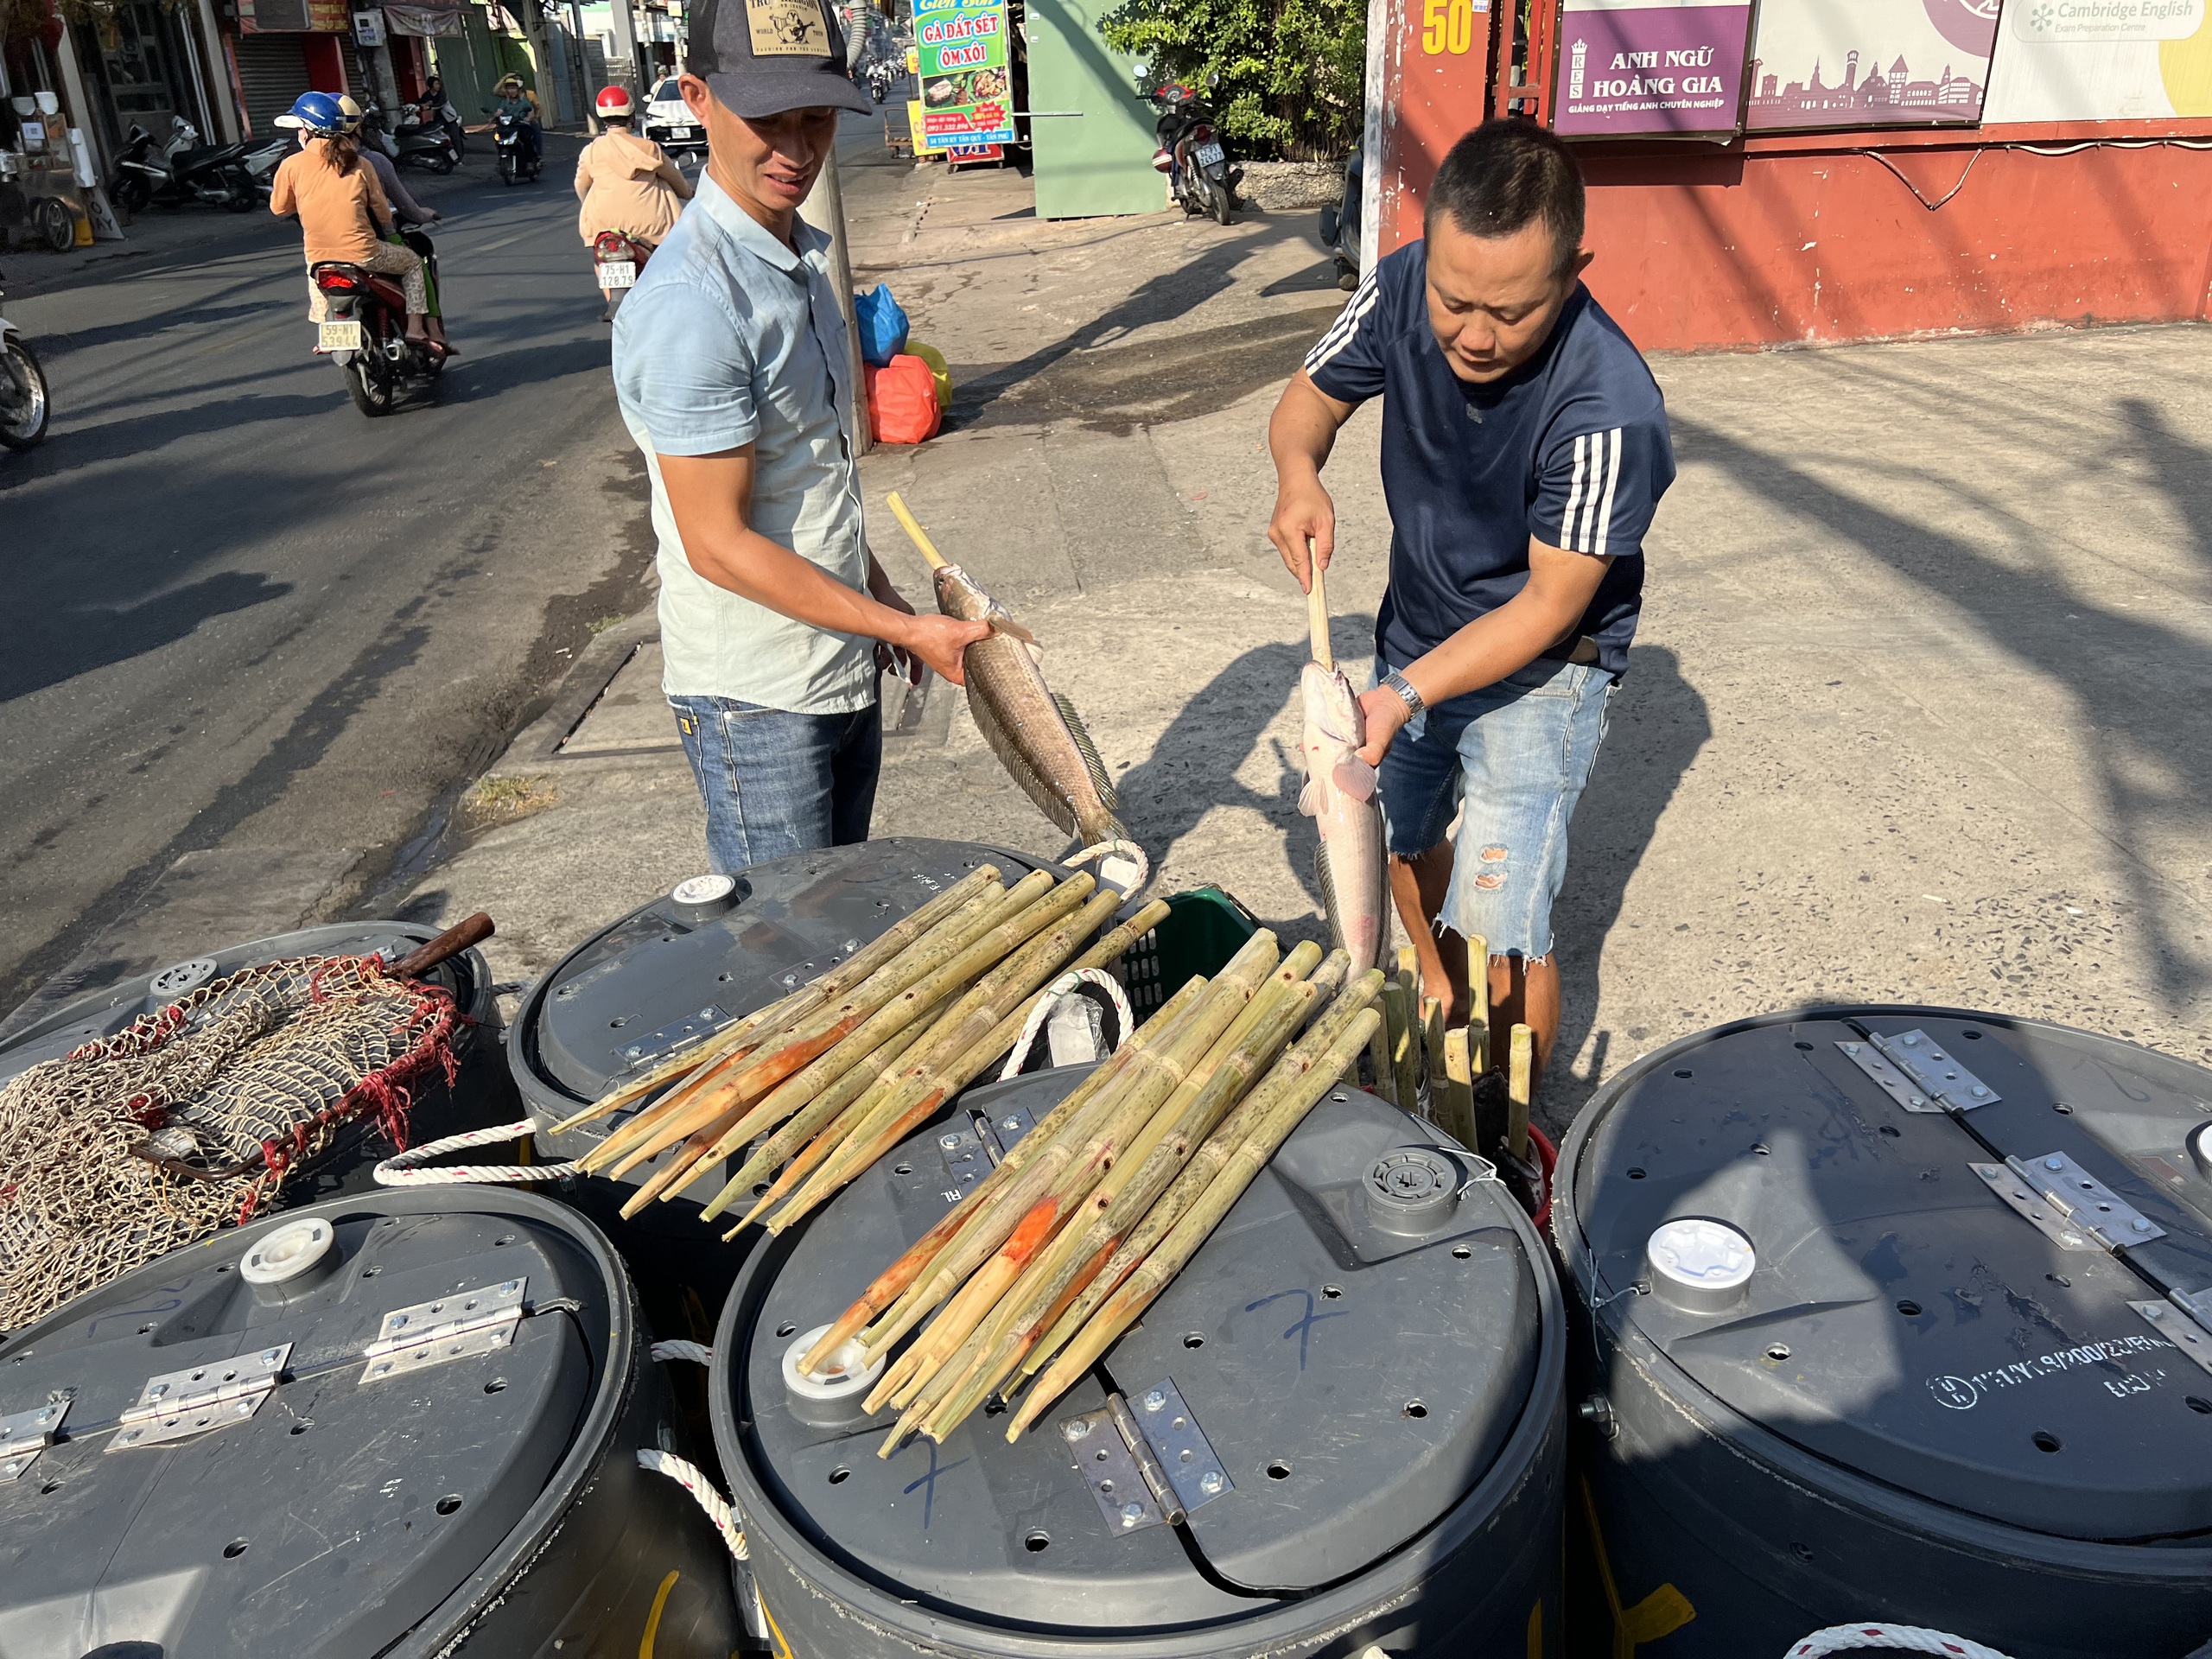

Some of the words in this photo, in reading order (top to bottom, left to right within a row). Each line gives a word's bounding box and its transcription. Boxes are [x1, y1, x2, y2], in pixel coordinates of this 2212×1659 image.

[2057, 0, 2137, 20] Cambridge
[2140, 0, 2193, 20] English
[924, 21, 944, 41] GÀ
[945, 14, 972, 39] ĐẤT
[975, 13, 997, 34] SÉT
[1422, 0, 1472, 55] 50
[2055, 24, 2076, 33] Exam
[2077, 22, 2120, 34] Preparation
[2120, 22, 2145, 32] Centre
[942, 47, 961, 66] ÔM
[963, 42, 986, 63] XÔI
[1609, 51, 1659, 70] ANH
[1664, 45, 1714, 68] NGỮ
[1592, 73, 1675, 98] HOÀNG
[1681, 76, 1723, 93] GIA
[1568, 103, 1595, 113] GIẢNG
[1596, 104, 1614, 114] DẠY
[1615, 100, 1638, 111] TIẾNG
[1660, 99, 1693, 109] CHUYÊN
[1694, 97, 1725, 110] NGHIỆP
[605, 264, 629, 275] 75-H1
[602, 276, 633, 286] 128.79
